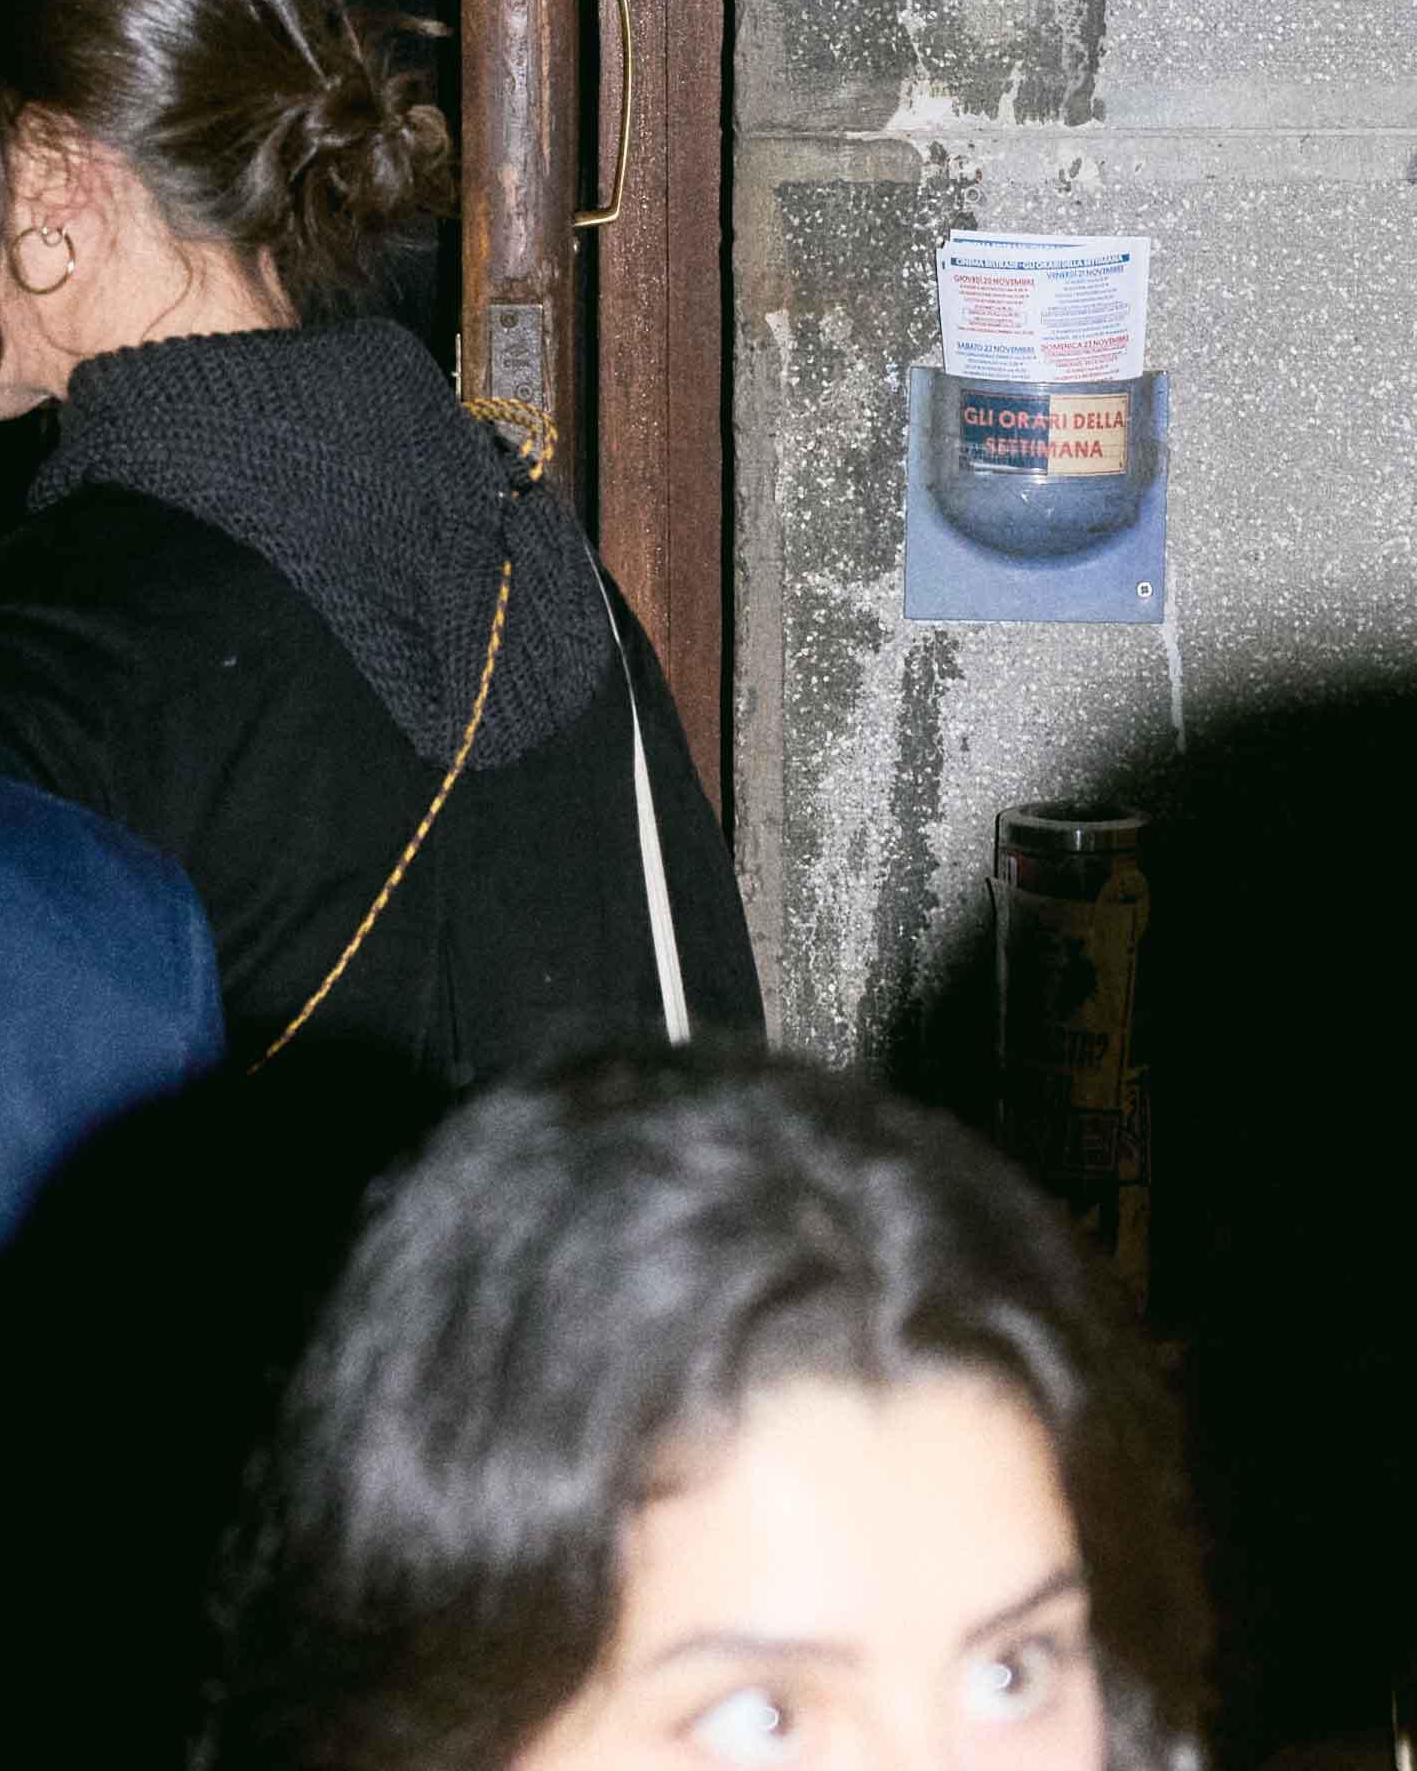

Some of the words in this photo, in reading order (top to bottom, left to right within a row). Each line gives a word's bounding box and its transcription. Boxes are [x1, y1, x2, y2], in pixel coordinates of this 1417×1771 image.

[964, 406, 994, 427] GLI
[998, 410, 1068, 431] ORARI
[1073, 410, 1126, 430] DELLA
[985, 436, 1104, 458] SETTIMANA
